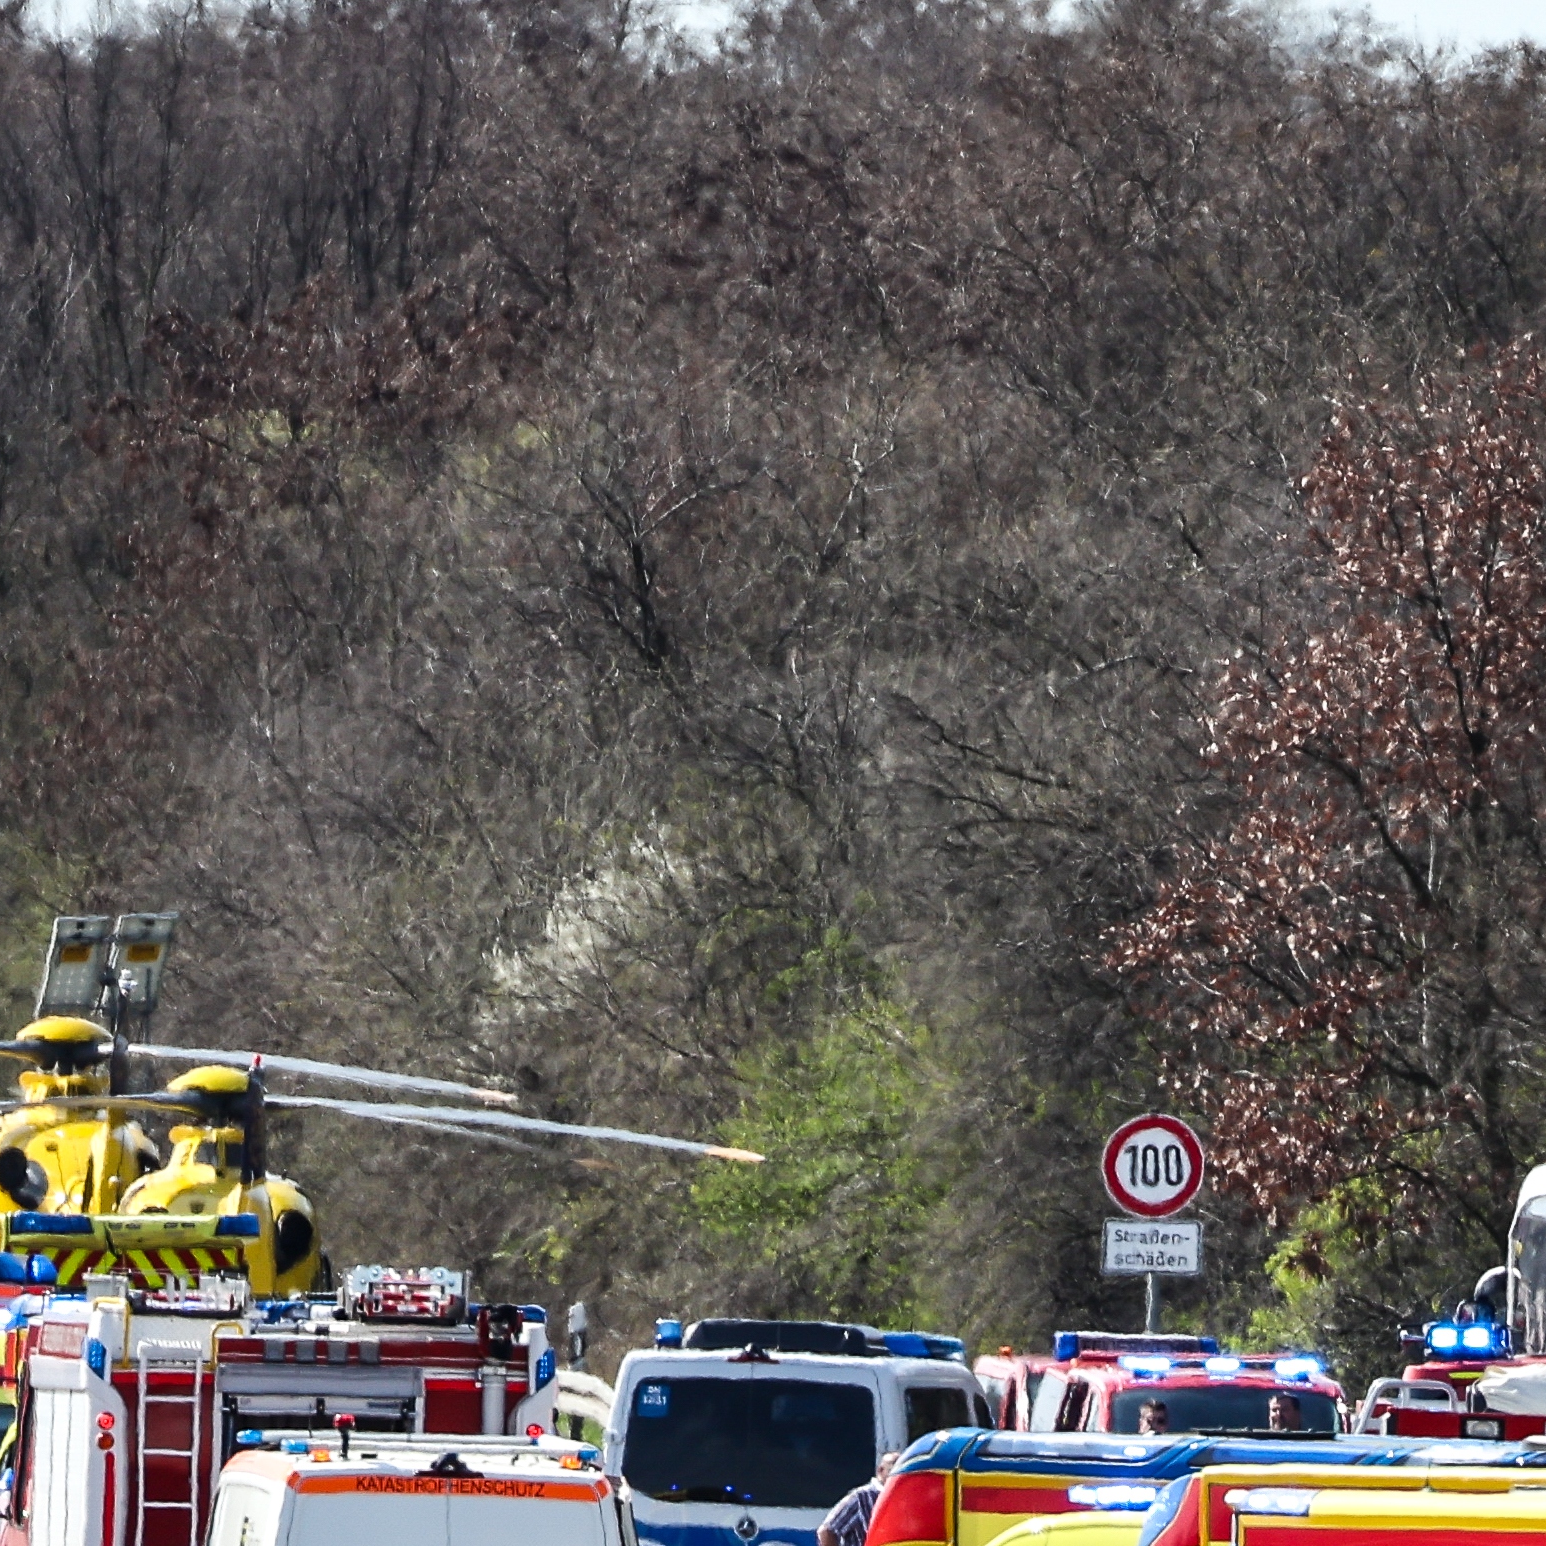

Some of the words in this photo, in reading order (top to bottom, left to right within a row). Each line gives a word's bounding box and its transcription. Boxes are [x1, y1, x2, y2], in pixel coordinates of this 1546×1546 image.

[1123, 1144, 1185, 1188] 100
[1114, 1228, 1191, 1246] Straßen-
[1113, 1250, 1189, 1267] schäden
[355, 1475, 546, 1498] KATASTROPHENSCHUTZ
